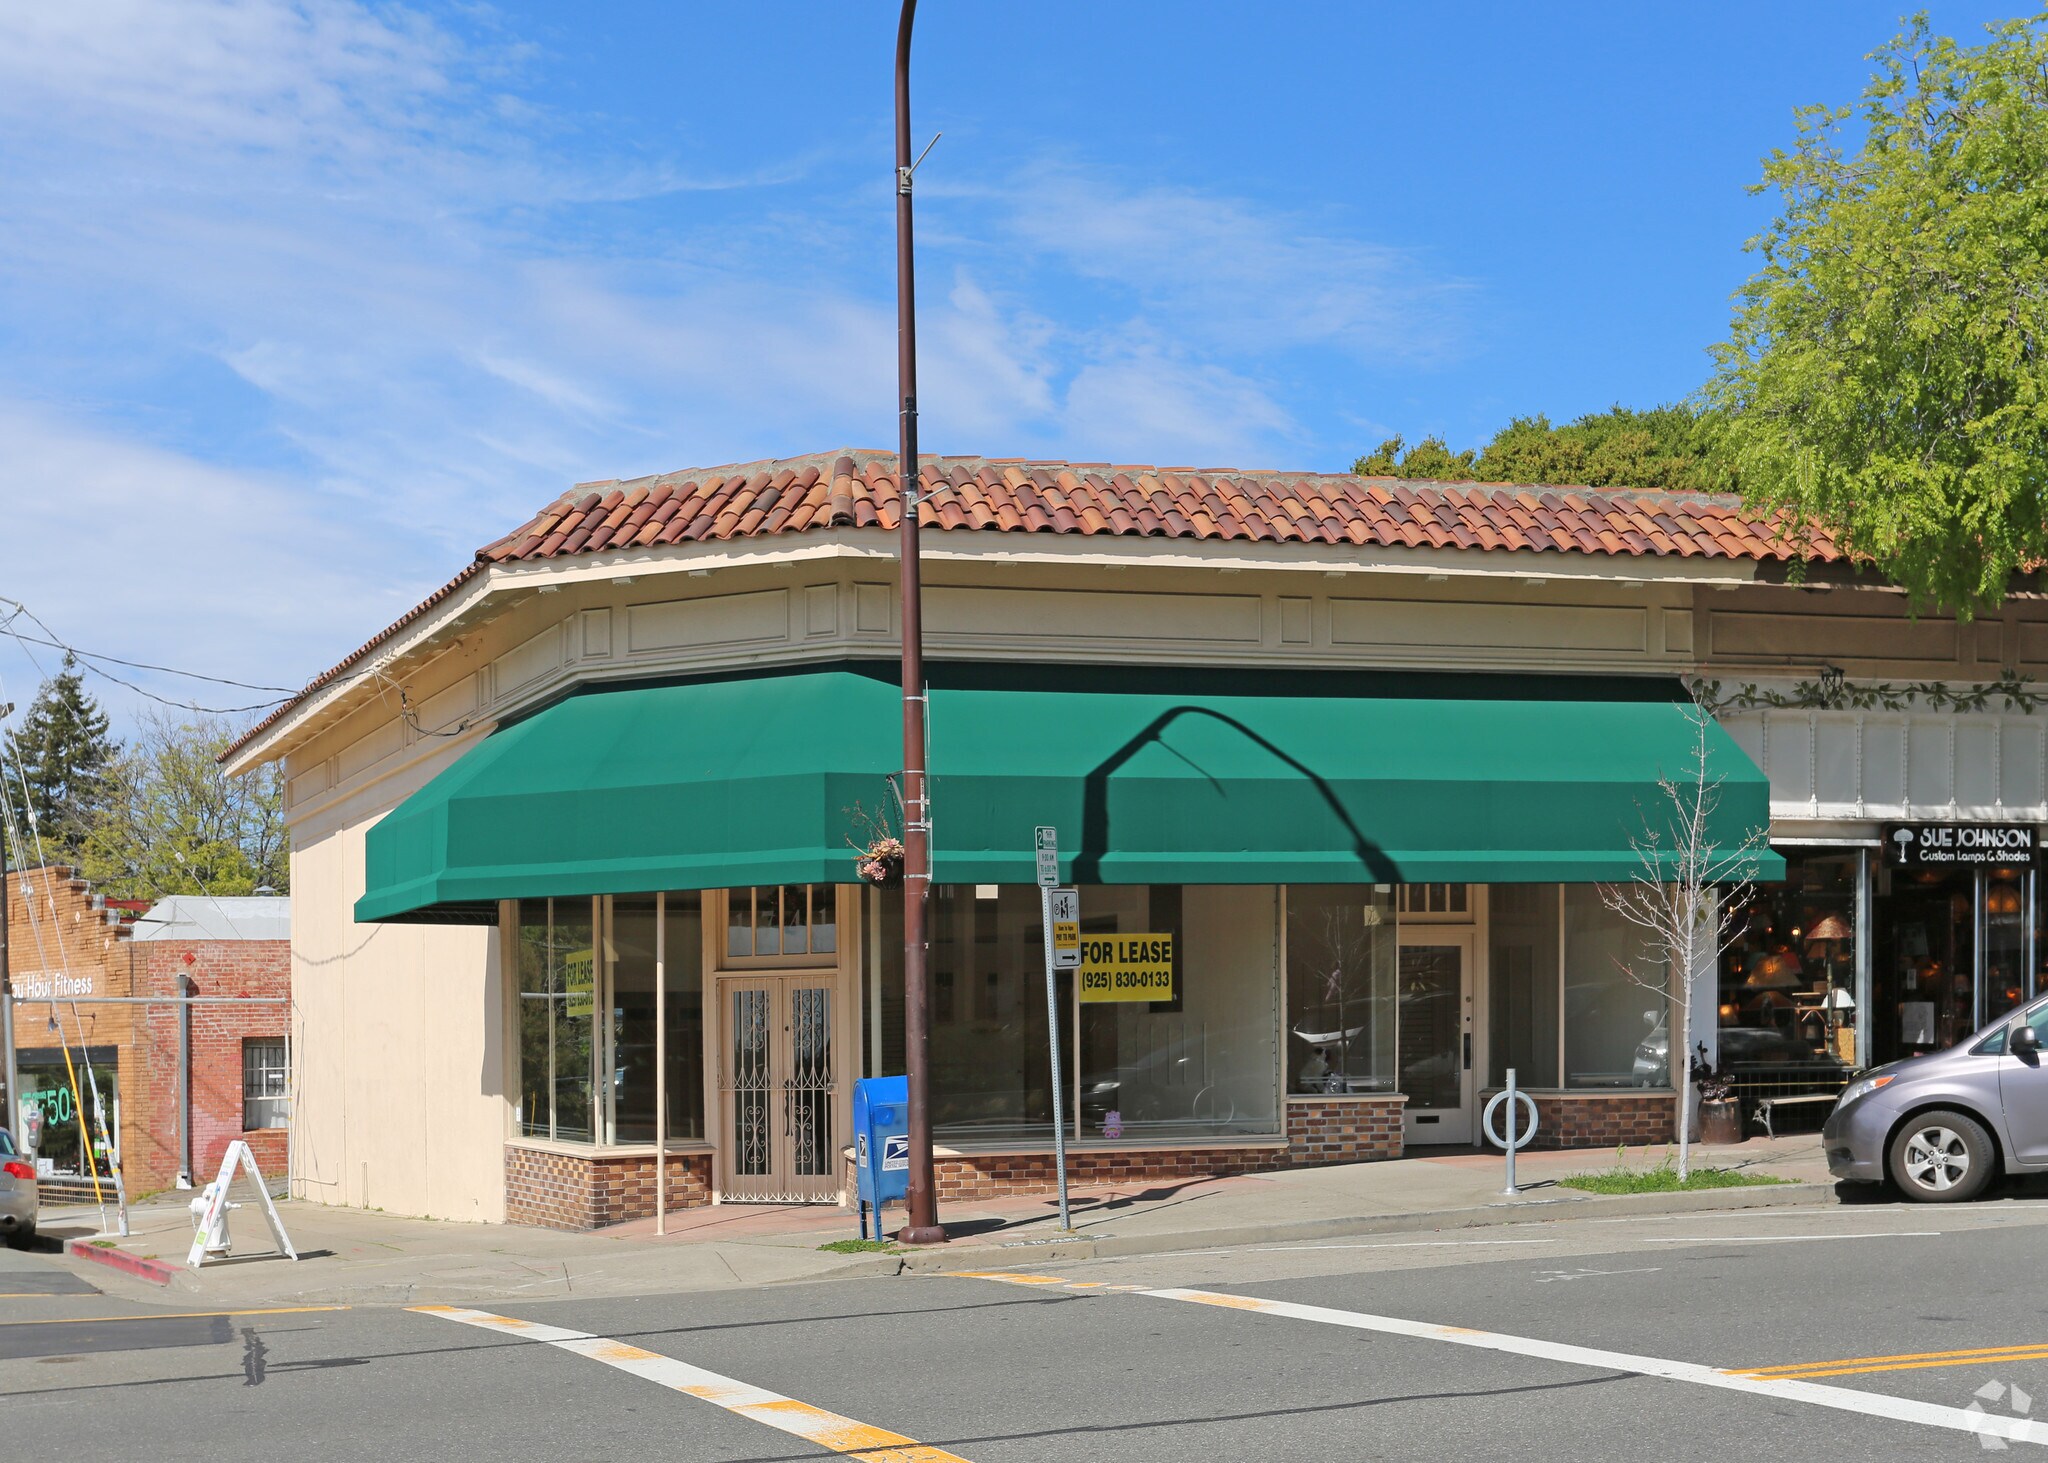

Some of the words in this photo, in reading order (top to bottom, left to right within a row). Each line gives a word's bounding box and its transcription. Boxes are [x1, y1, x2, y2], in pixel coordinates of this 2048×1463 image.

[1038, 831, 1042, 846] 2
[1920, 828, 1952, 847] SUE
[1956, 828, 2031, 848] JOHNSON
[1920, 850, 1954, 861] Custom
[1957, 850, 1986, 862] Lamps
[1986, 850, 1995, 862] &
[1996, 850, 2030, 862] Shades
[1081, 942, 1113, 964] FOR
[1118, 941, 1171, 963] LEASE
[567, 962, 577, 986] FOR
[1082, 972, 1112, 992] (925)
[1116, 971, 1170, 988] 830-0133
[27, 975, 52, 998] Hour
[54, 973, 92, 996] Fitness
